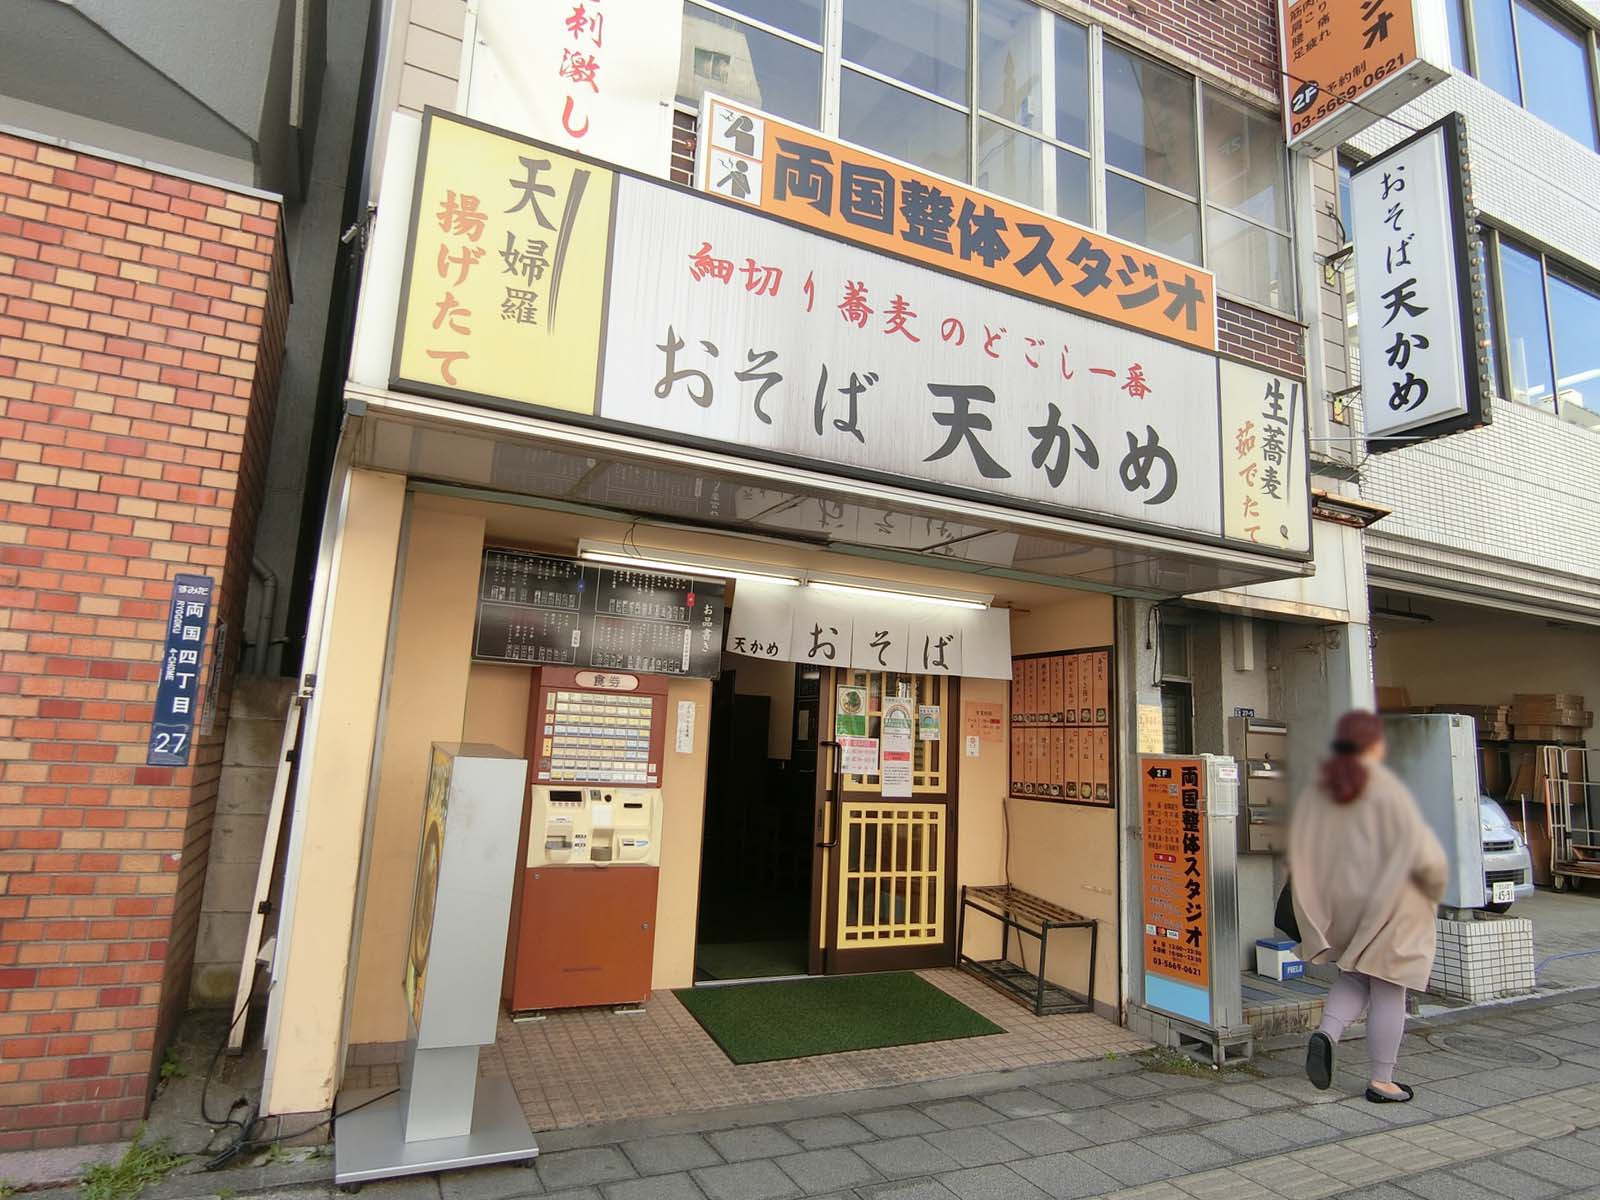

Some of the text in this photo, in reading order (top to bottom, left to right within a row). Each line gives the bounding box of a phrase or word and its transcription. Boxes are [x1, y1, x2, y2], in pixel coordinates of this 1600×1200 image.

[559, 0, 604, 153] 刺激し
[1292, 52, 1405, 136] 03-5669-0621
[1293, 82, 1318, 113] 2F
[499, 155, 558, 326] 天婦羅
[773, 136, 1207, 332] 両国整体スタジオ
[425, 189, 489, 386] 揚げたて
[688, 241, 1153, 401] 細切り蕎麦のどごし一番
[1234, 420, 1262, 545] 茹でたて
[1260, 378, 1288, 501] 生蕎麦
[172, 599, 186, 635] RYOGOKU
[172, 600, 206, 714] 両国四丁目
[701, 603, 714, 653] お品書き
[734, 636, 780, 658] 天かめ
[807, 621, 954, 671] おそば
[593, 674, 621, 688] 食券
[154, 732, 188, 754] 27
[1156, 769, 1169, 778] 2F
[1181, 766, 1203, 949] 両国整体スタジオ
